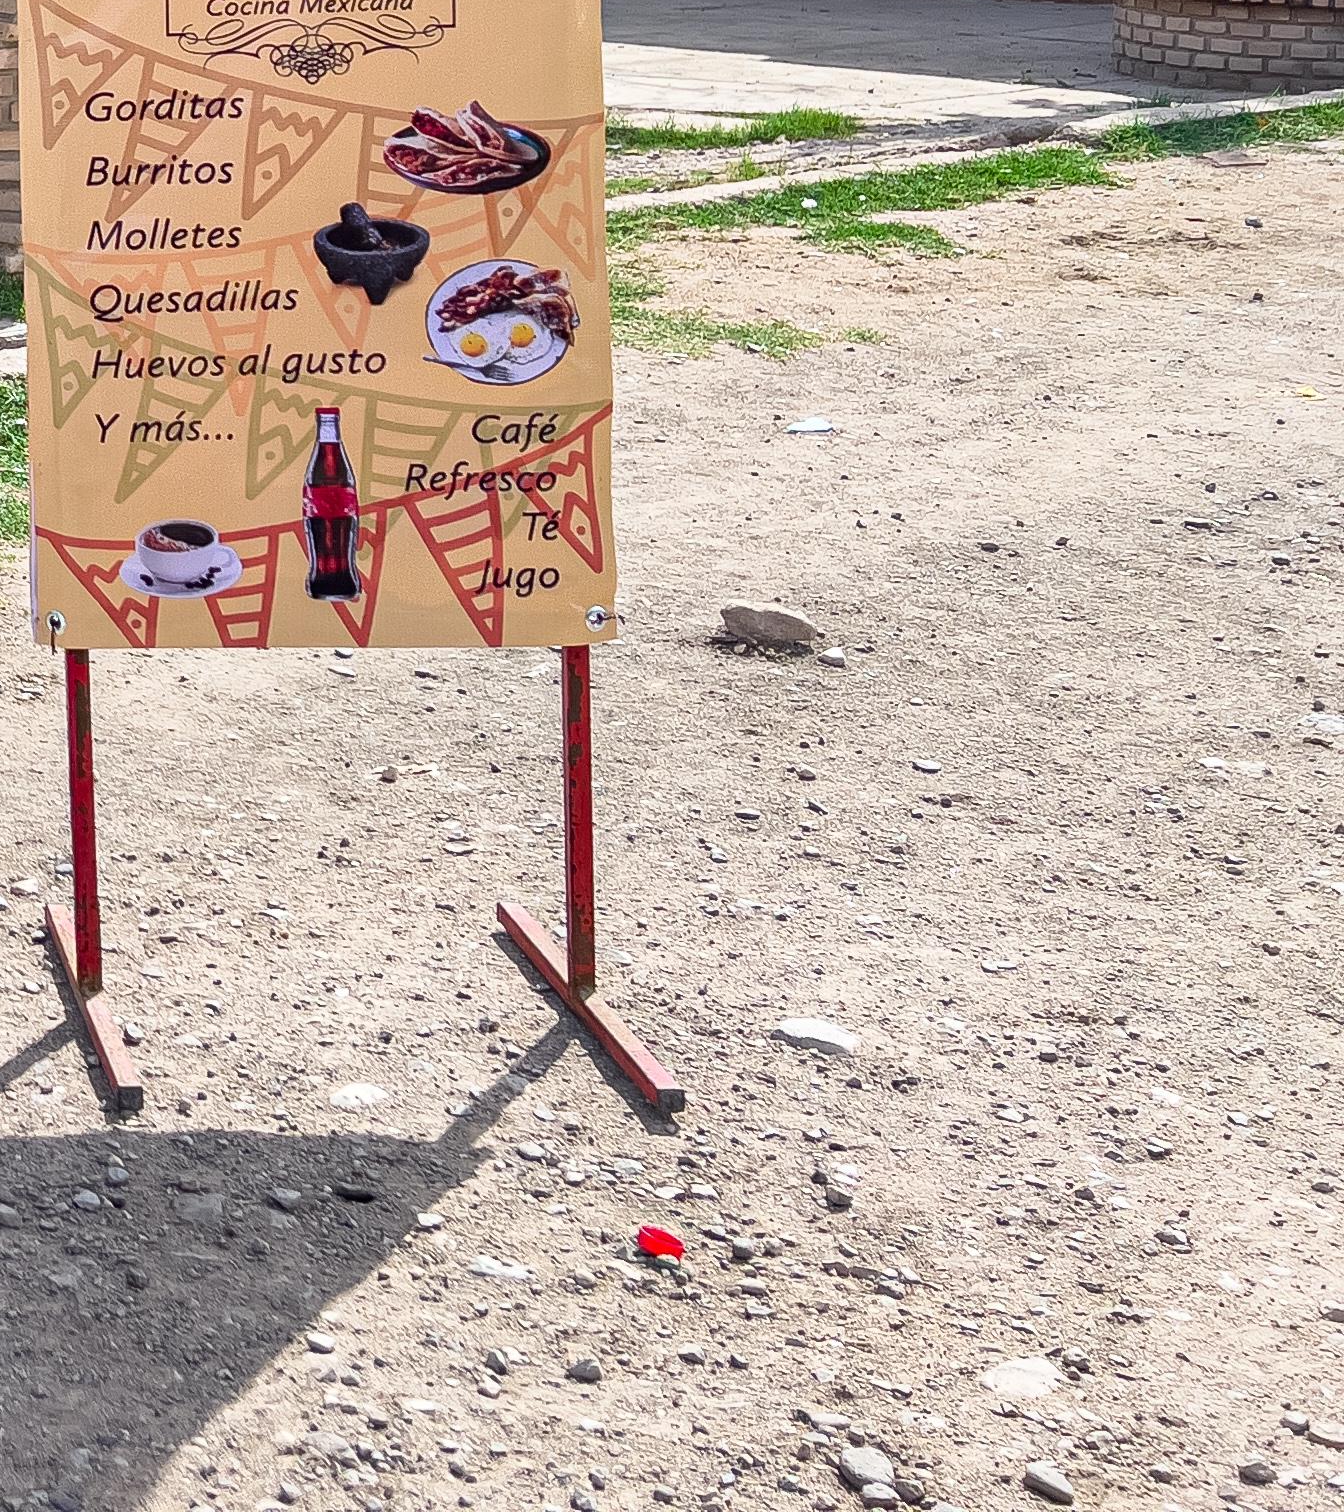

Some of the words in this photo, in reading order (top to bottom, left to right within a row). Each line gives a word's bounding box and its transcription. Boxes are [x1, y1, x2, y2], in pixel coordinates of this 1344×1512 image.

[84, 88, 244, 122] Gorditas
[86, 154, 234, 187] Burritos
[86, 217, 242, 251] Molletes
[89, 279, 299, 323] Quesadillas
[91, 348, 226, 380] Huevos
[238, 343, 272, 377] al
[281, 348, 387, 384] gusto
[94, 413, 120, 444] Y
[129, 410, 234, 443] más...
[471, 412, 560, 451] Café
[405, 460, 557, 499] Refresco
[521, 509, 562, 541] Té
[474, 559, 560, 596] Jugo
